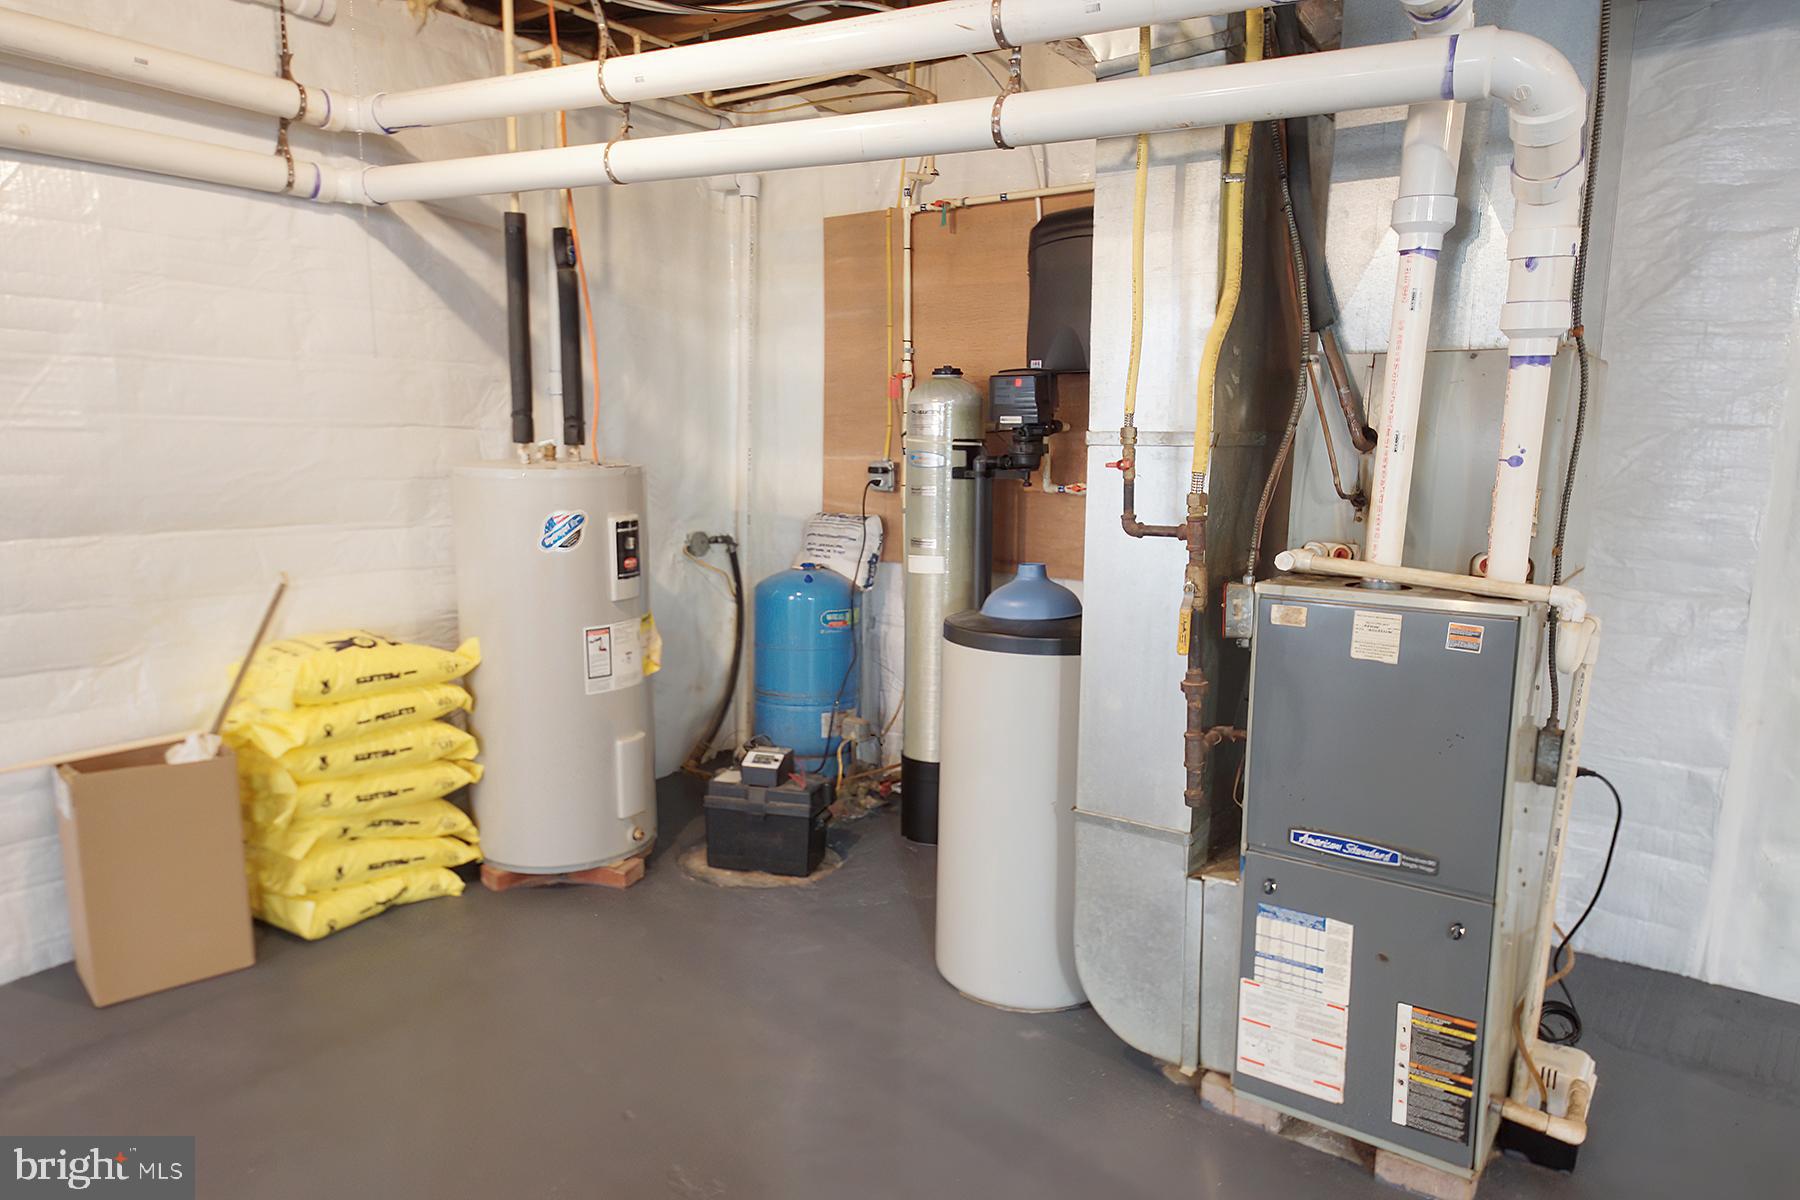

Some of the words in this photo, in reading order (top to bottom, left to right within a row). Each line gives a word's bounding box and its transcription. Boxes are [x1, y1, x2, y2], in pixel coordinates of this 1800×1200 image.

[375, 706, 416, 720] PELLETS
[1298, 833, 1342, 851] American
[1342, 843, 1392, 862] Standard
